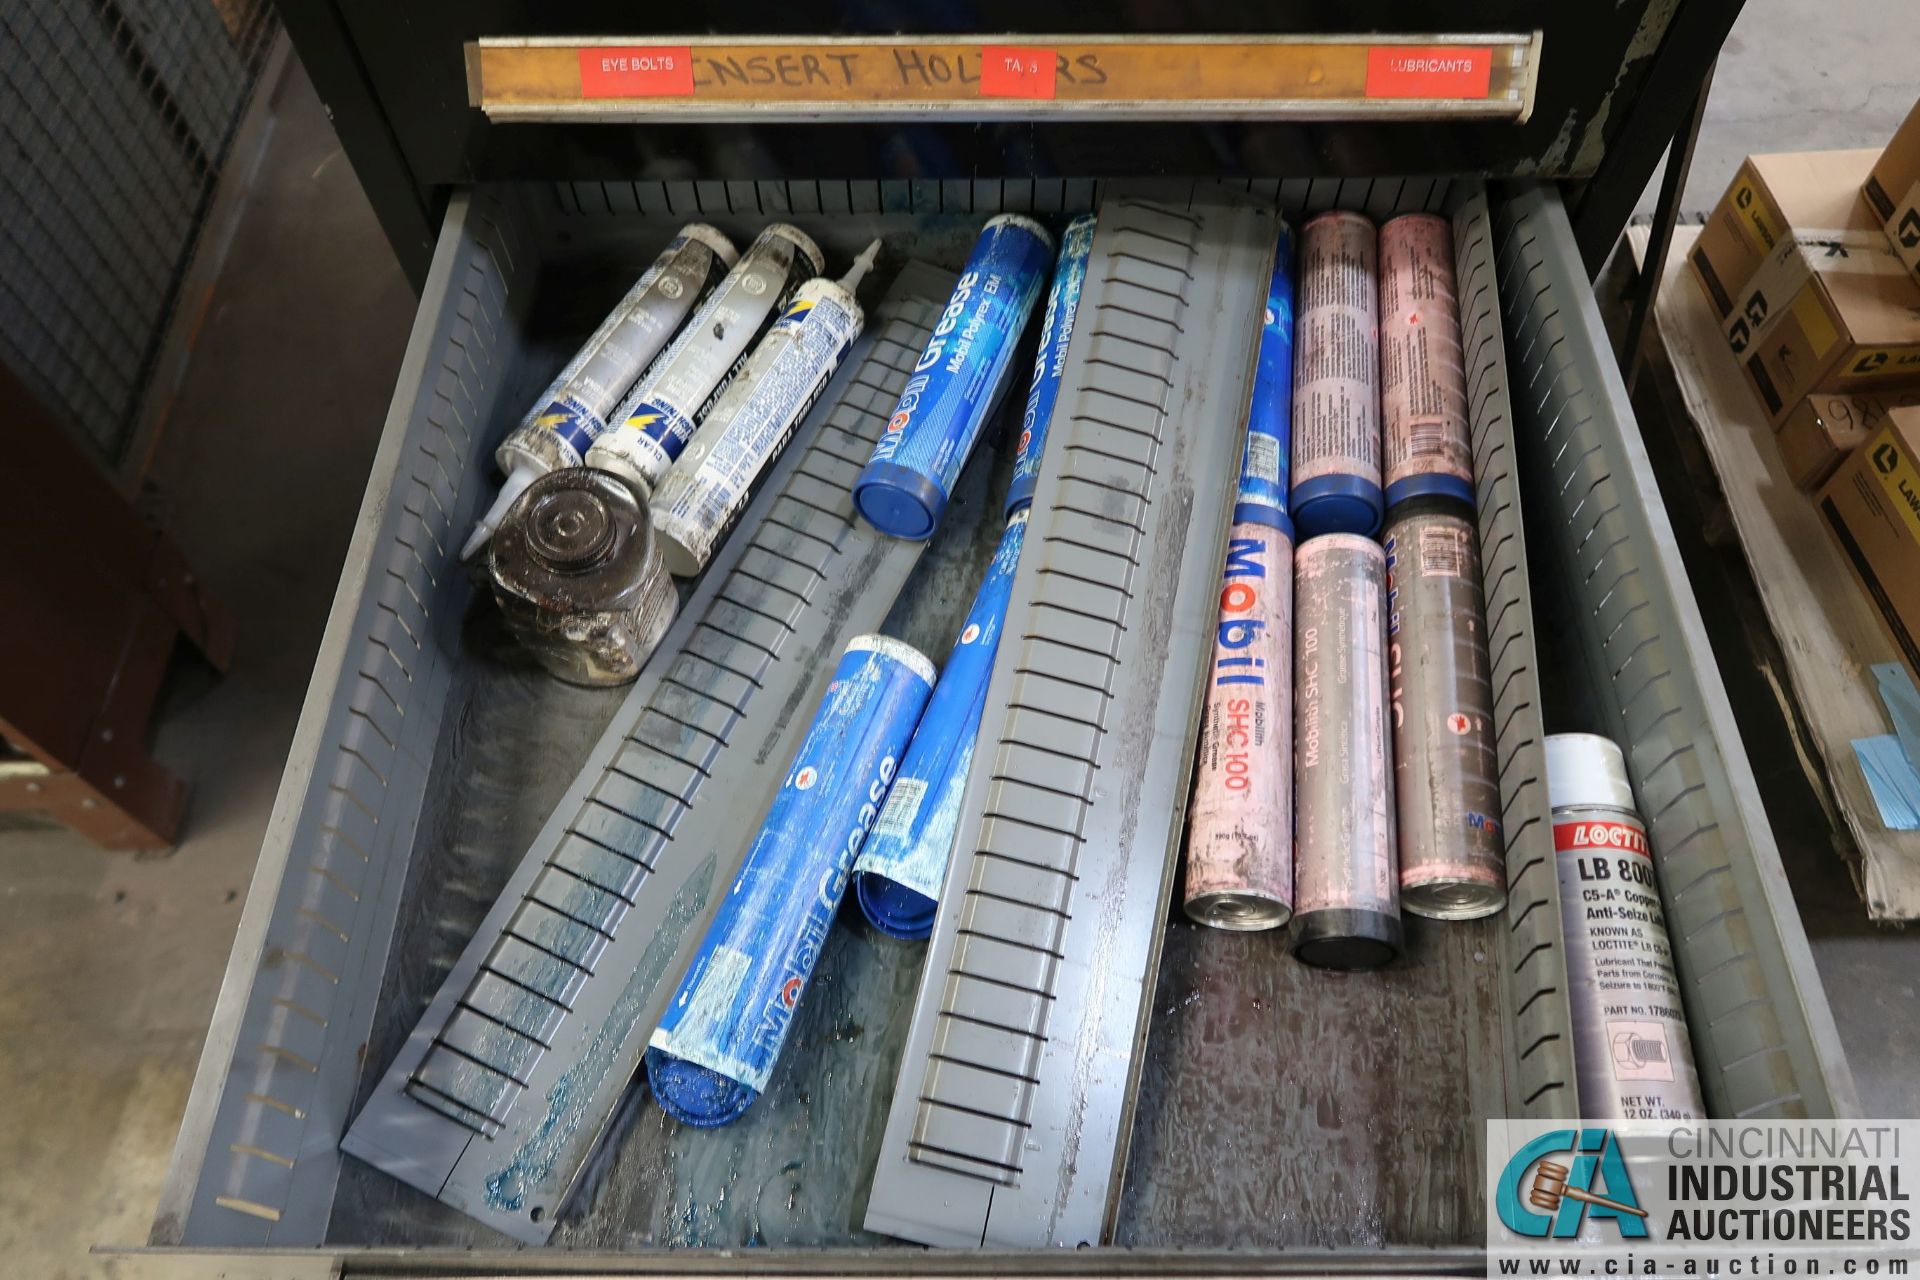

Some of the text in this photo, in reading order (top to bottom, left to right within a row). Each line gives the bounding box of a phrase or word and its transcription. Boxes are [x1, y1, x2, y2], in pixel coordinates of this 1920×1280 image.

[602, 56, 674, 72] EYE BOLTS
[893, 48, 1108, 86] HOLRS
[1004, 57, 1038, 73] TAS
[1389, 58, 1473, 73] LUBRICANTS
[946, 336, 972, 374] Mobil
[968, 298, 992, 339] Polyrex
[984, 273, 1002, 295] EM
[869, 374, 930, 463] Mobil
[915, 271, 979, 373] Grease
[1051, 340, 1069, 378] Mobil
[637, 436, 663, 462] CLEAR
[1217, 538, 1266, 686] Mobil
[1305, 627, 1320, 768] Mobilith SHC 100
[1225, 699, 1250, 791] SHC 100
[1578, 857, 1611, 881] LB
[752, 753, 897, 1053] Mobil Grease
[1587, 906, 1648, 922] Anti-Seize
[1590, 927, 1644, 938] KNOWN AS
[1595, 958, 1635, 967] Lubricant
[1637, 959, 1653, 967] That
[1597, 969, 1620, 979] Parts
[1622, 969, 1641, 977] from
[1600, 981, 1632, 990] Seizure
[1633, 981, 1642, 990] to
[1604, 1005, 1628, 1015] PART
[1631, 1006, 1647, 1016] NO.
[1621, 1097, 1665, 1108] NET WT.
[1624, 1109, 1637, 1119] 12
[1641, 1109, 1658, 1119] OZ.
[1660, 1109, 1682, 1120] (340
